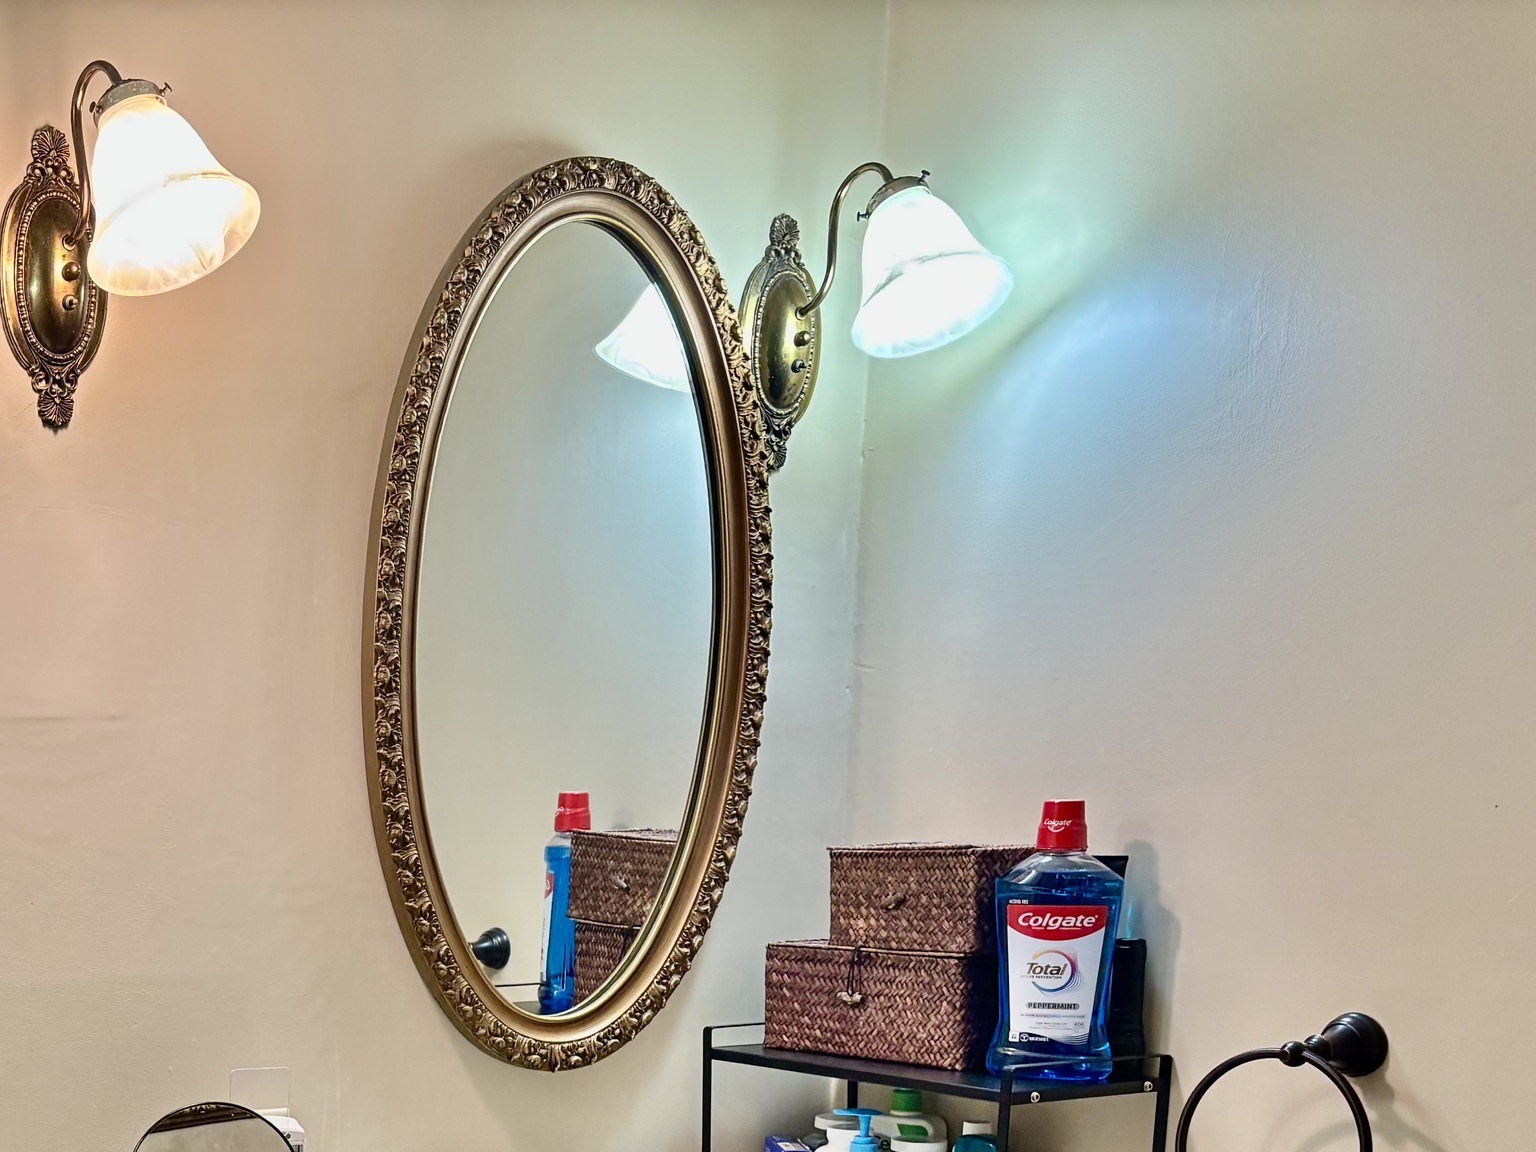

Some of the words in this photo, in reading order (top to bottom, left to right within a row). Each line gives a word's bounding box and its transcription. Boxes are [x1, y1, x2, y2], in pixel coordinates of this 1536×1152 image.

[1044, 818, 1072, 827] Colgate
[1018, 912, 1096, 930] Colgate
[1027, 962, 1068, 976] Total
[1027, 1002, 1078, 1011] PEPPERMINT
